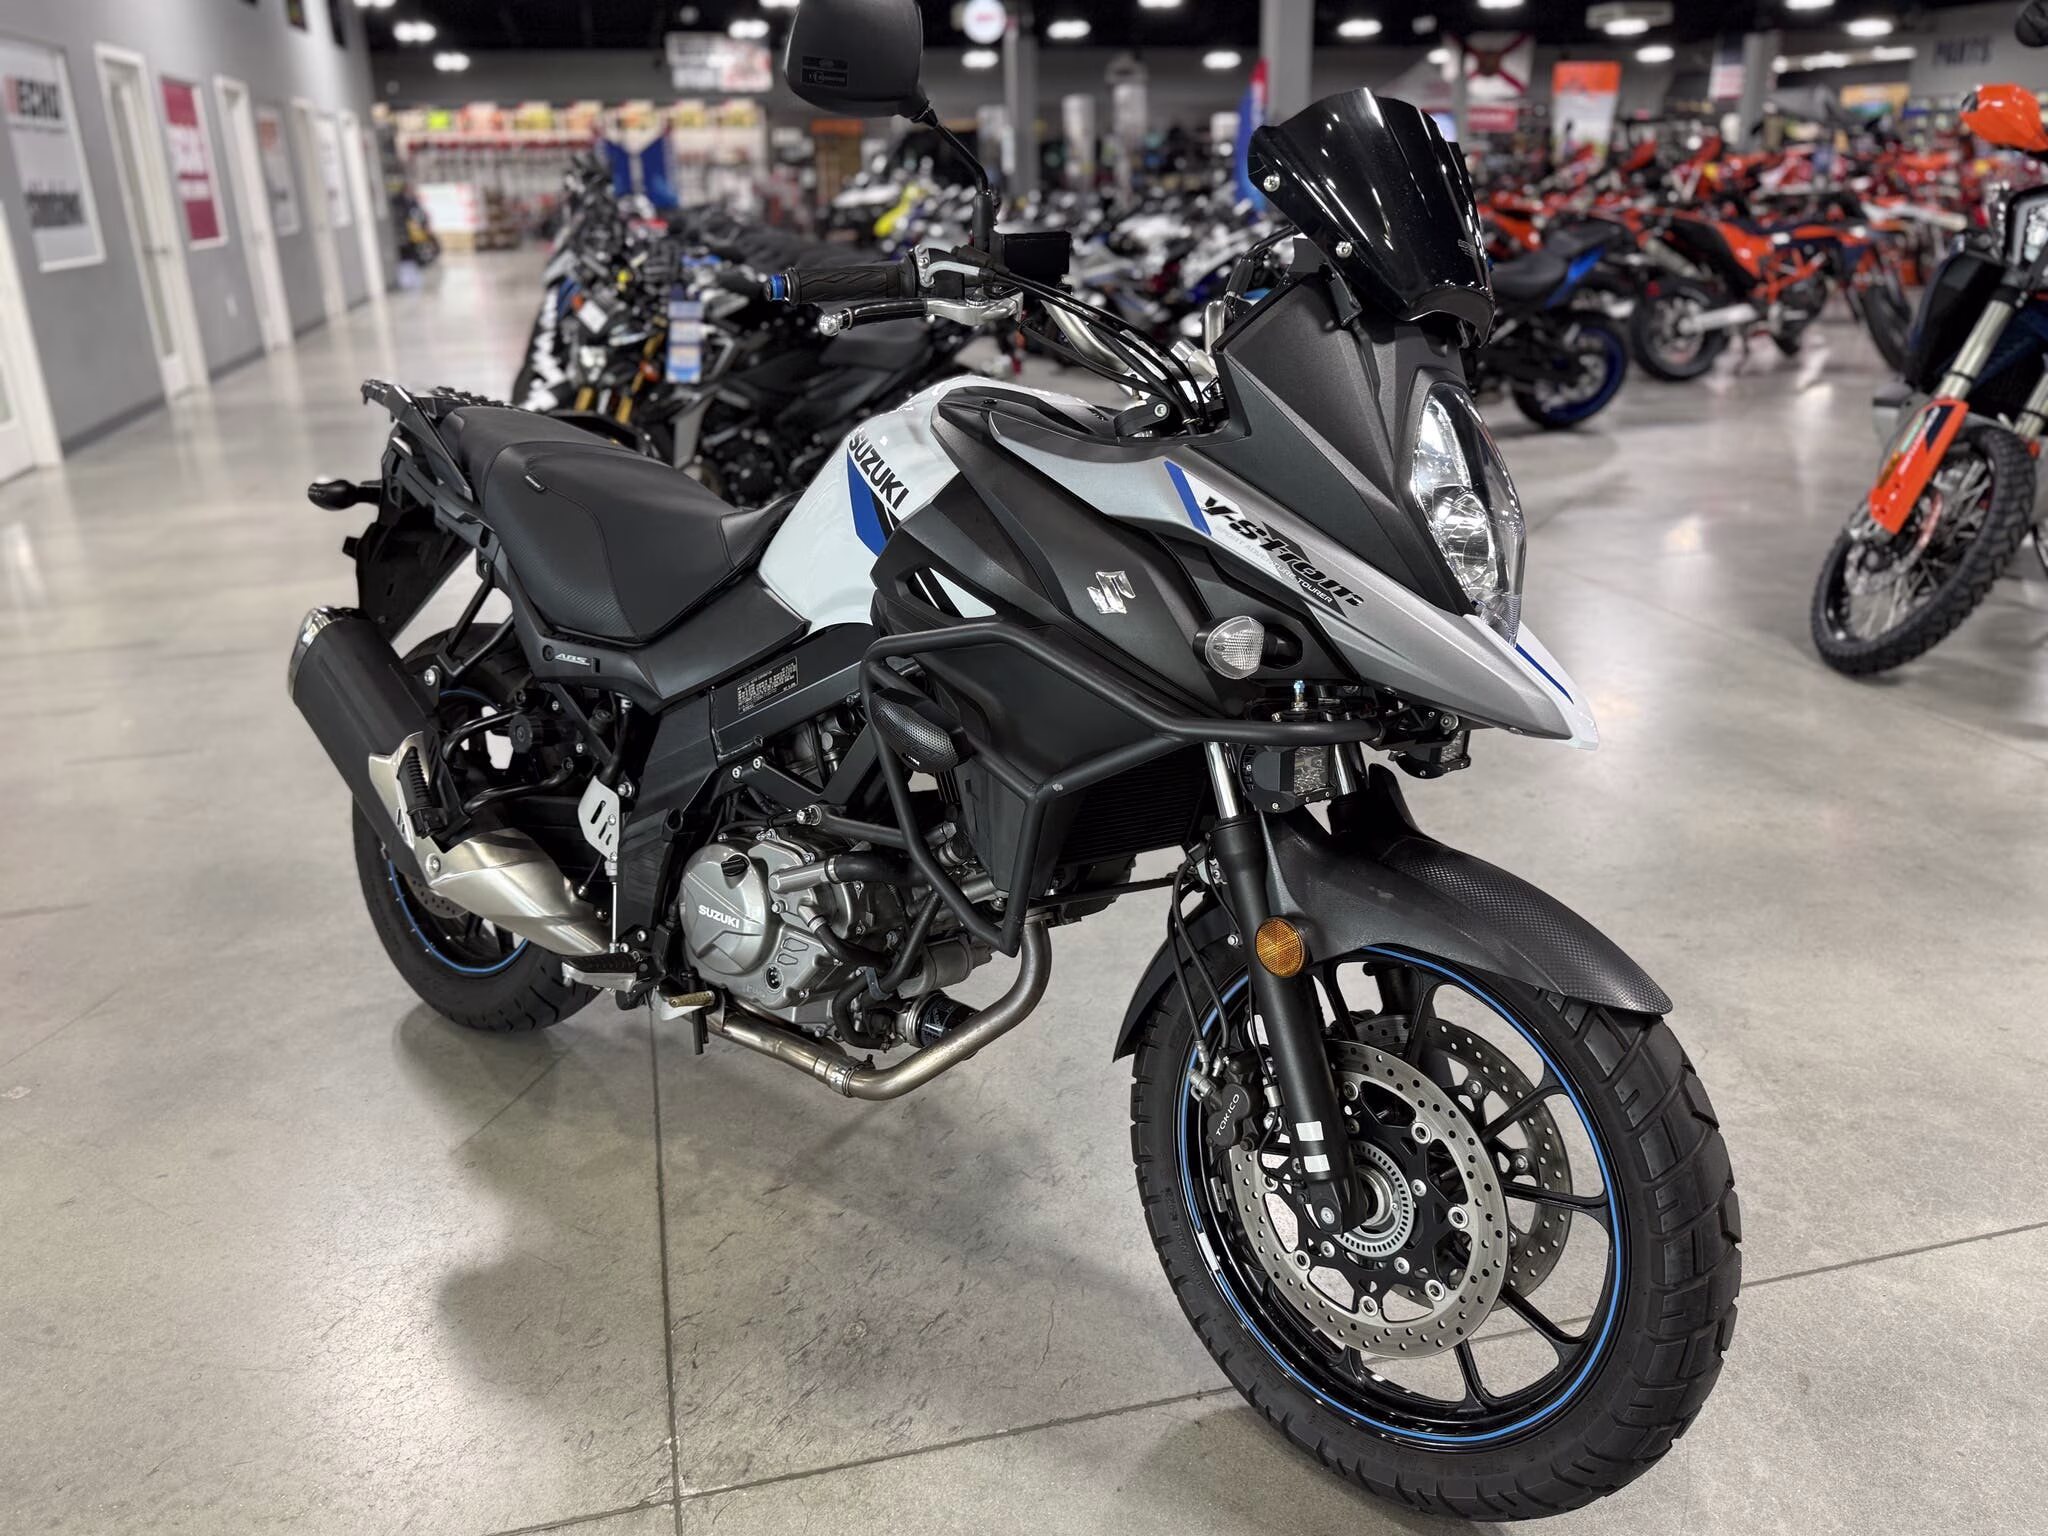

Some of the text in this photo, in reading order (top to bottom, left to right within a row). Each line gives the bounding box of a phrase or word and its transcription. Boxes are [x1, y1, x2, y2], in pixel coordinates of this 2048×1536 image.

[849, 431, 909, 510] SUZUKI
[1215, 525, 1246, 547] SPORT
[1297, 576, 1333, 603] TOURER
[555, 653, 590, 666] ABS
[699, 904, 740, 929] SUZUKI
[1216, 1094, 1240, 1136] TOKICO
